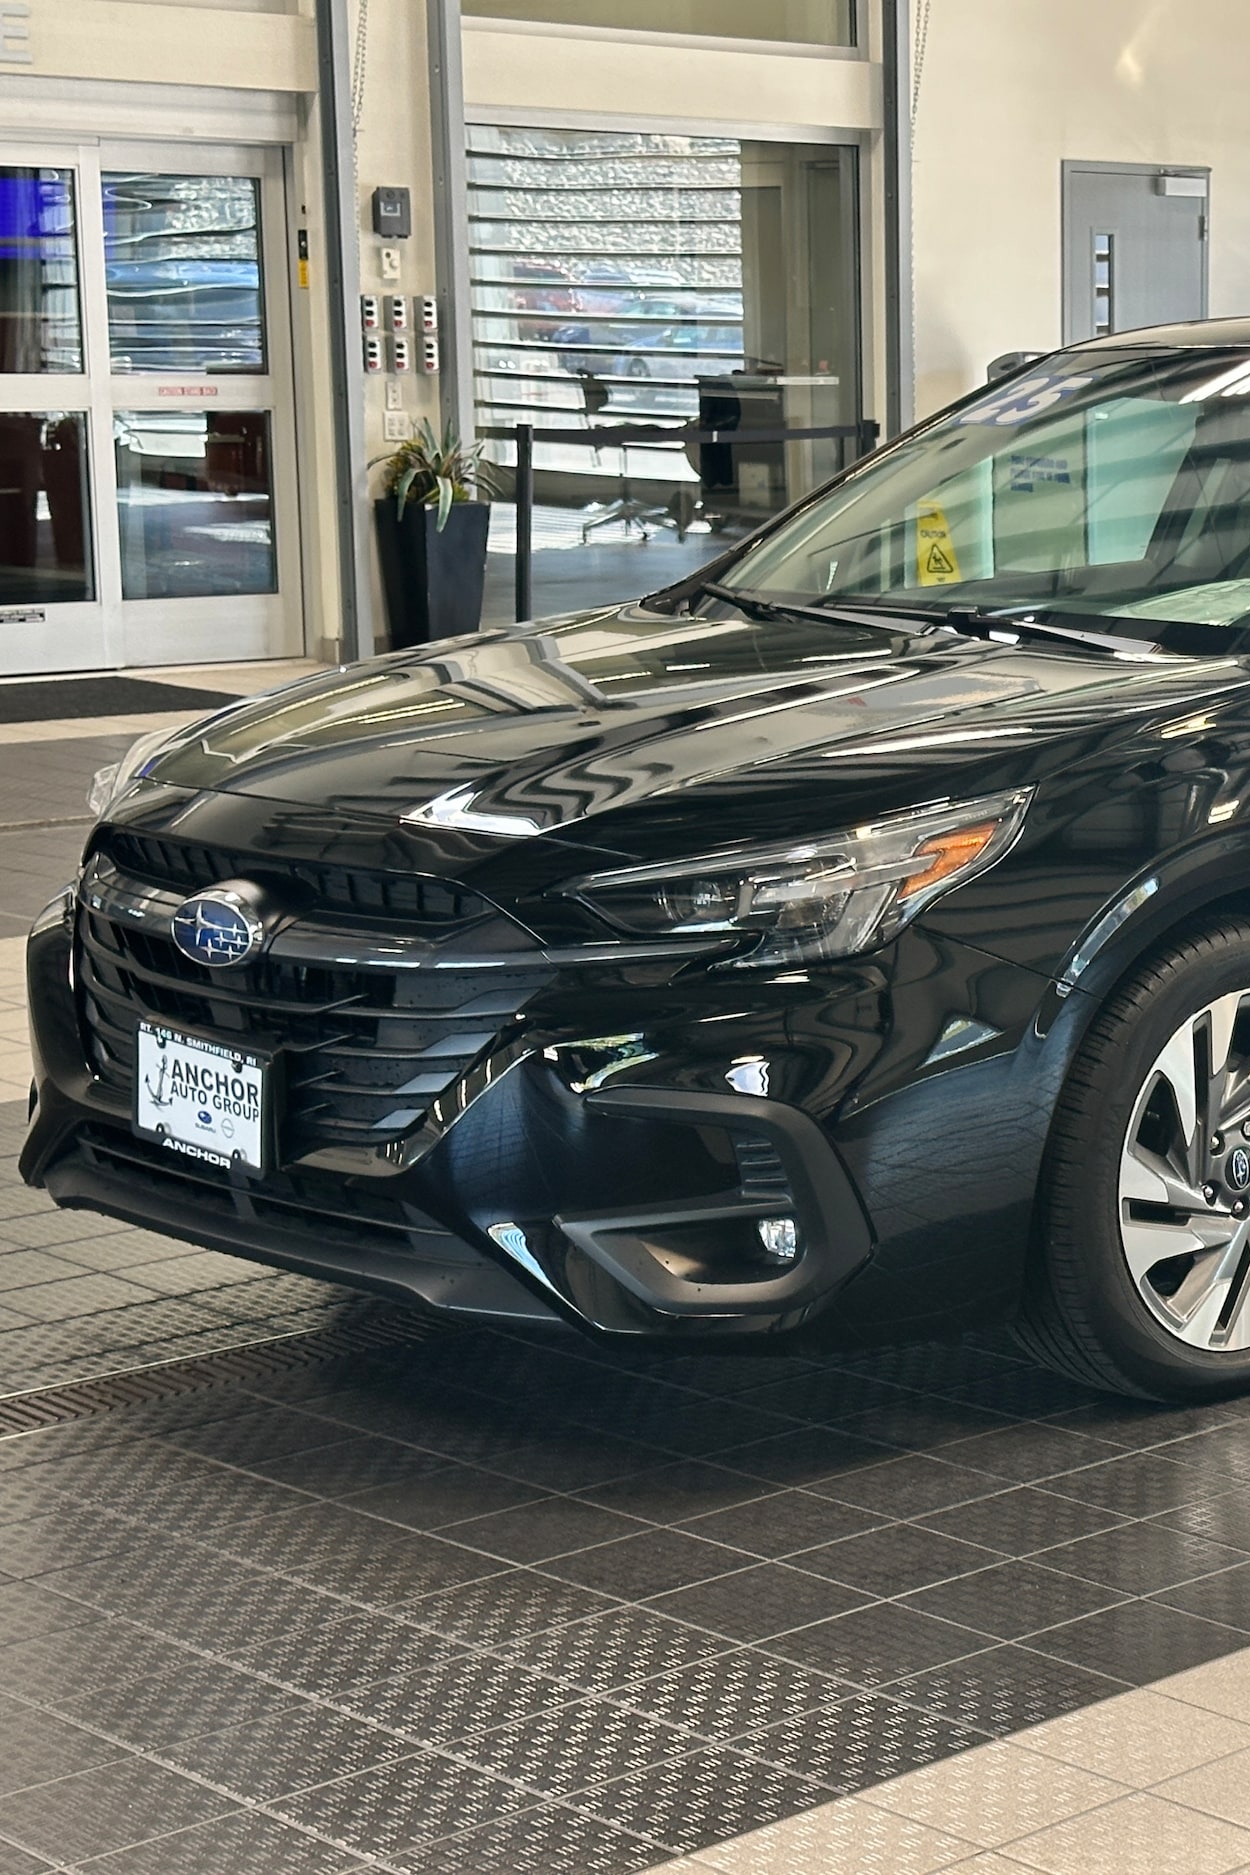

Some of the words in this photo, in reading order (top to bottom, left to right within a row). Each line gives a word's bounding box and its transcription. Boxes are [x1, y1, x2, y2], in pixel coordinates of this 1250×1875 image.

[959, 377, 1093, 425] 25
[140, 1021, 154, 1034] RT.
[173, 1033, 185, 1044] N.
[186, 1037, 245, 1064] SMITHFIELD,
[246, 1056, 257, 1067] RI
[170, 1080, 207, 1105] AUTO
[213, 1095, 259, 1122] GROUP
[171, 1058, 259, 1108] ANCHOR
[162, 1137, 231, 1169] ANCHOR
